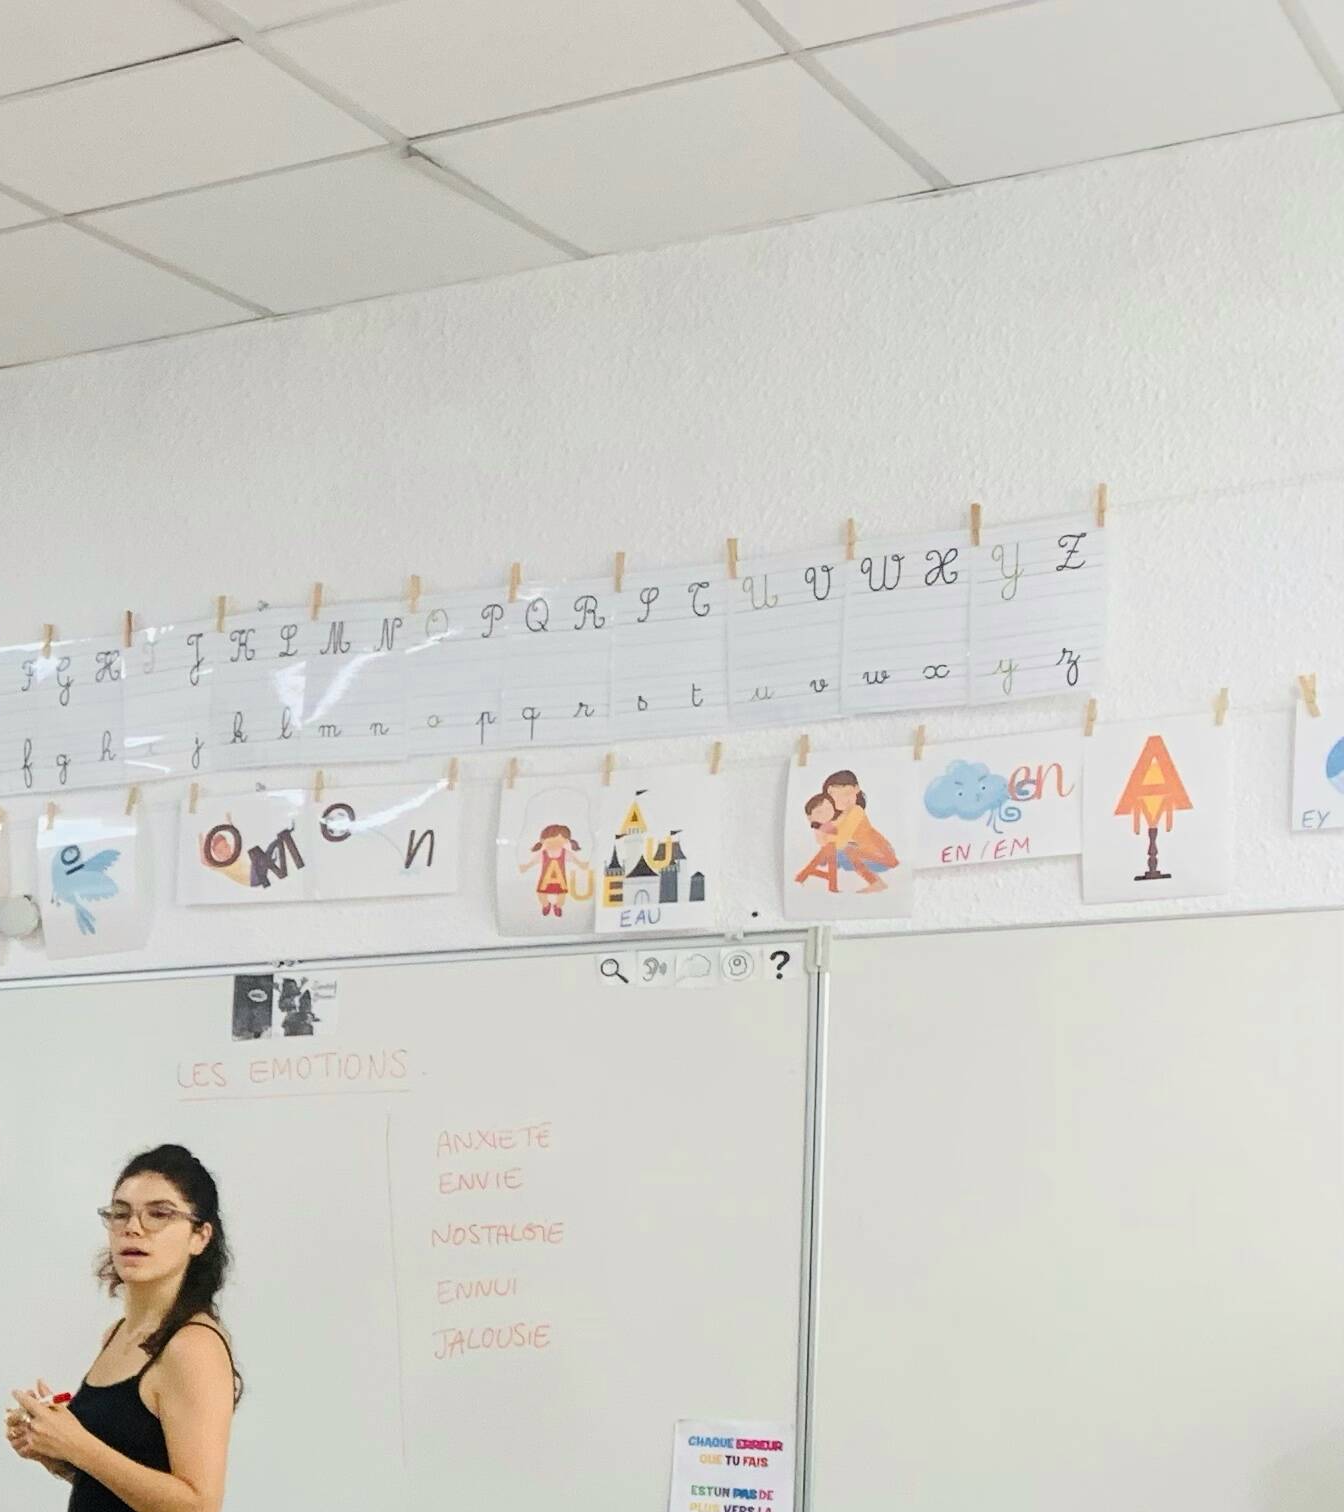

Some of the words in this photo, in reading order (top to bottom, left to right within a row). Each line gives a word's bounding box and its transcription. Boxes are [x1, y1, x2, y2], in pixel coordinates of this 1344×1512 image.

[619, 908, 661, 929] EAU
[177, 1062, 227, 1088] LES
[439, 1168, 522, 1194] ENVIE
[437, 1279, 517, 1304] ENNUI
[432, 1323, 551, 1359] JALOUSIE
[688, 1436, 734, 1449] CHAQUE
[725, 1455, 740, 1467] TU
[743, 1456, 768, 1468] FAIS
[759, 1490, 774, 1501] DE
